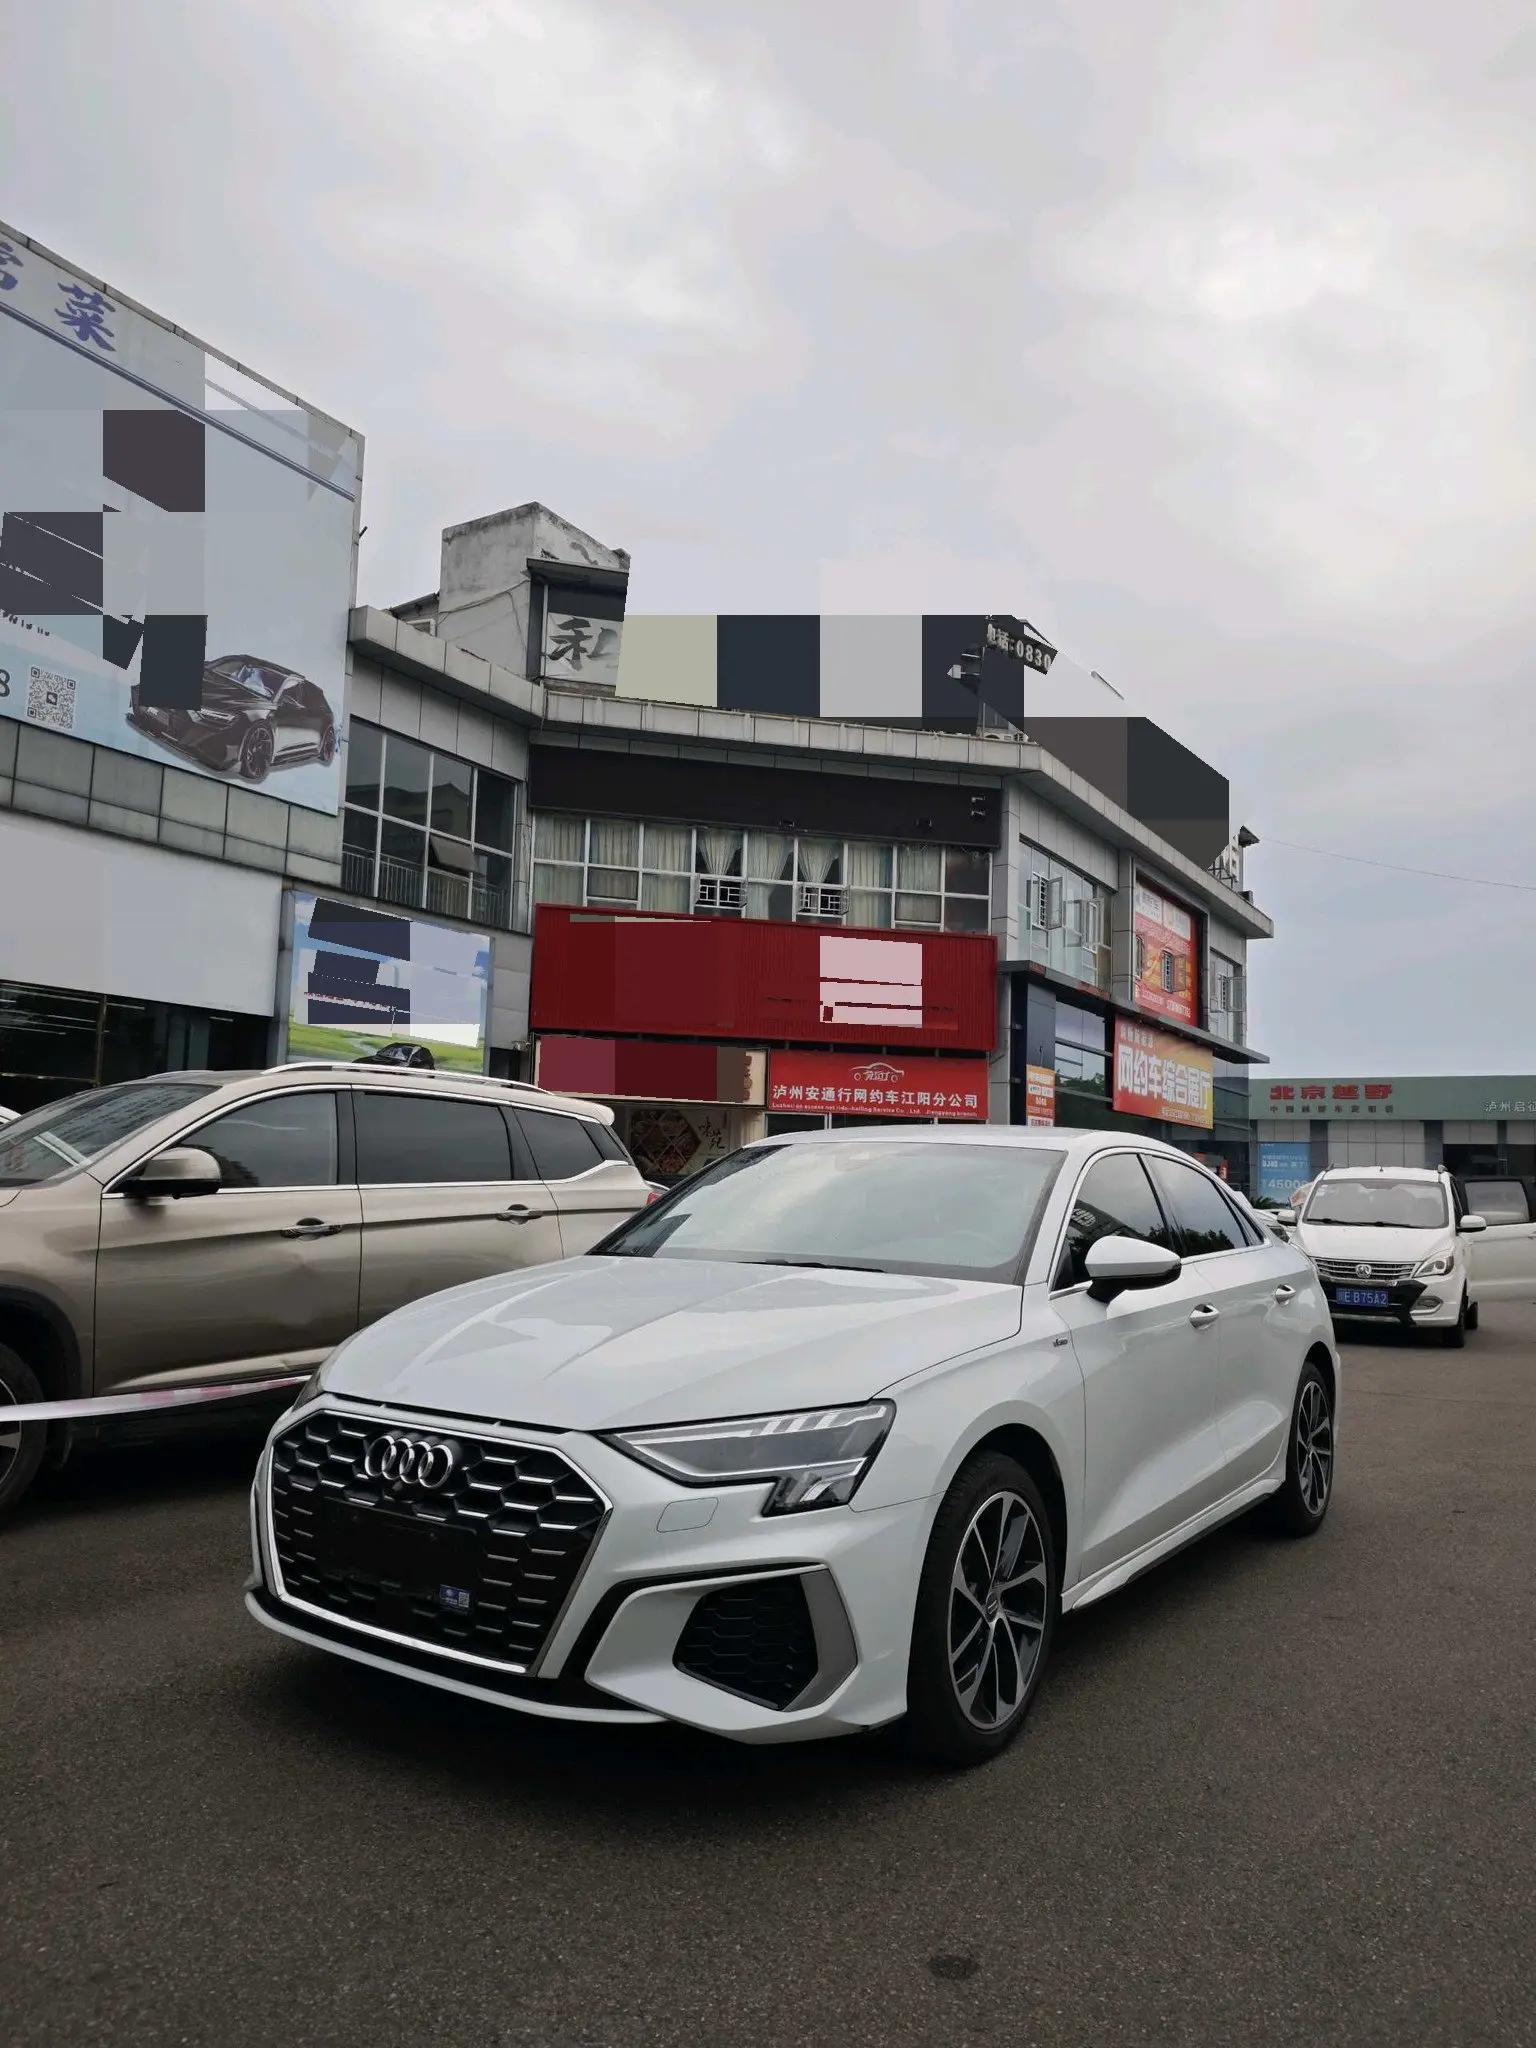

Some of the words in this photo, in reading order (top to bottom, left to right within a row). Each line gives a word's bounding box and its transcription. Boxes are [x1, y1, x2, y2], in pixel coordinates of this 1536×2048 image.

[772, 1084, 978, 1109] 泸州安通行网约车江阳分公司
